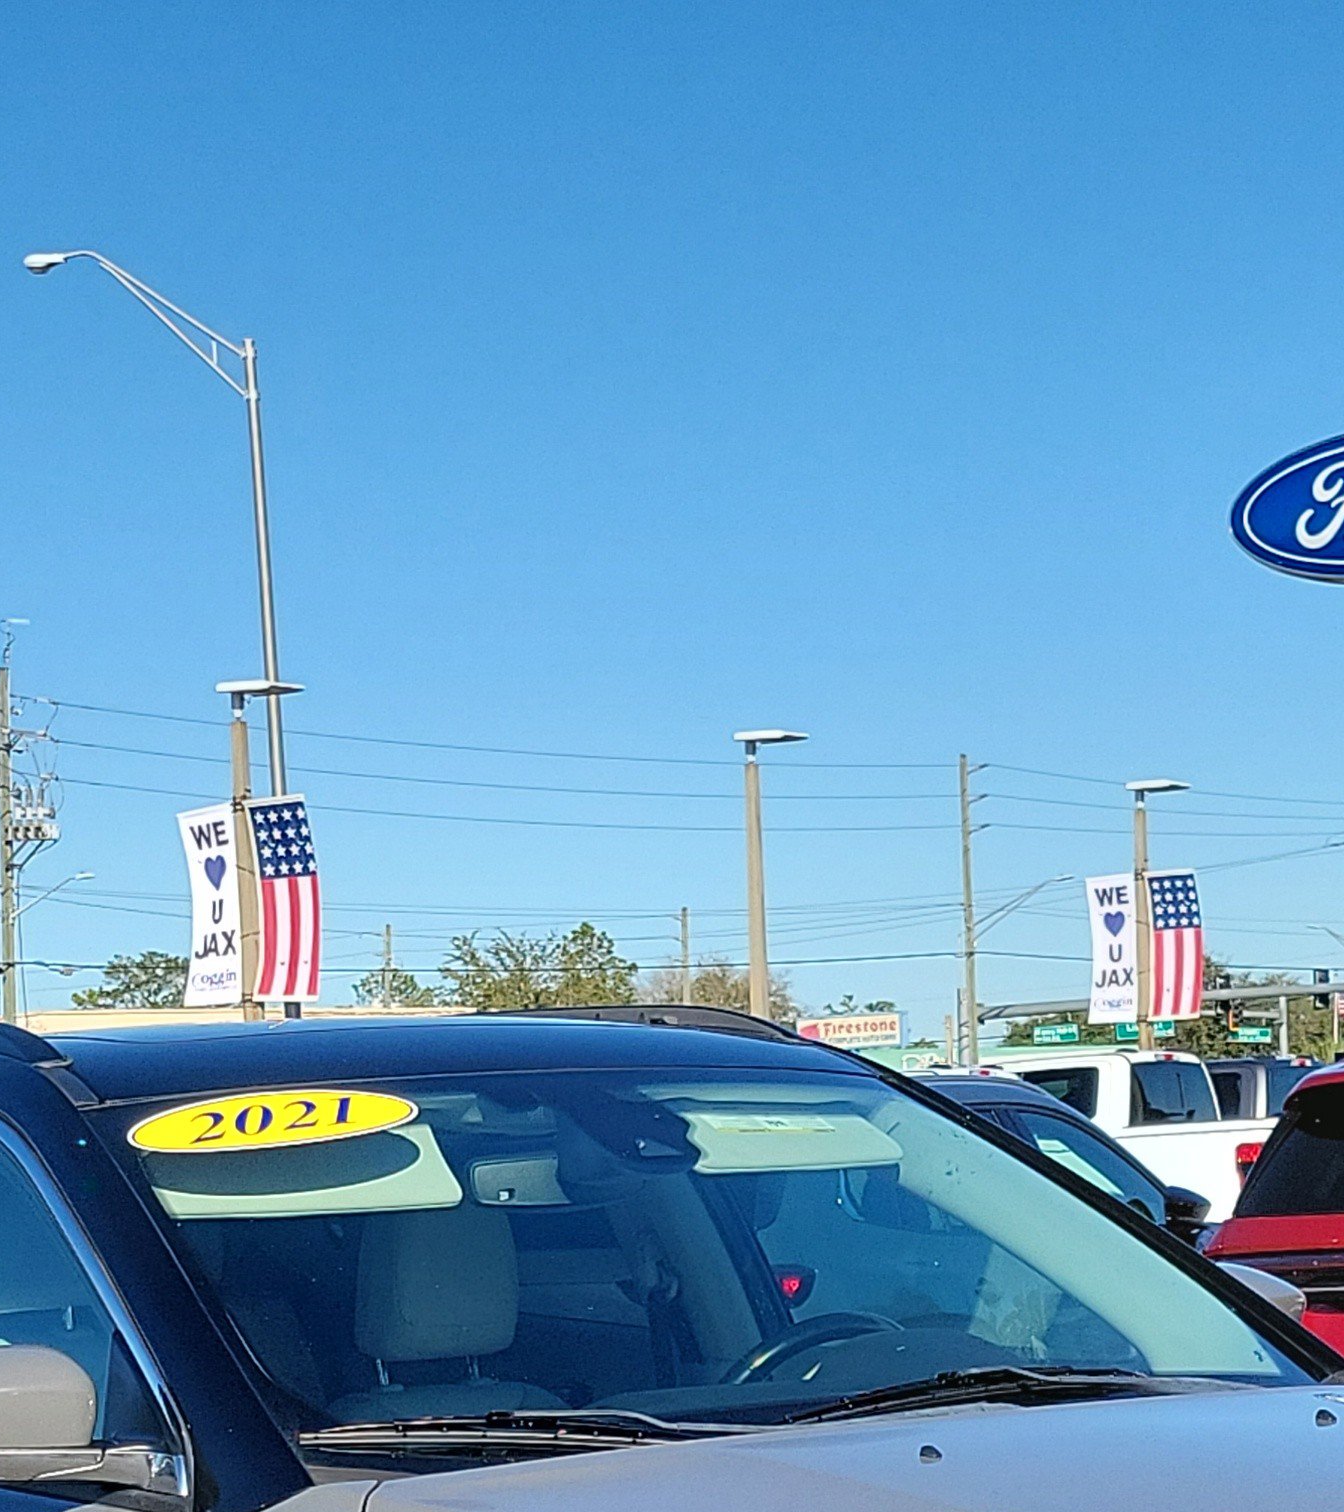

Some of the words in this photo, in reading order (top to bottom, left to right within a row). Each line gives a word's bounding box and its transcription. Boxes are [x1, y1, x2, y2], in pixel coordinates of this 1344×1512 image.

[189, 820, 230, 850] WE
[1094, 885, 1130, 908] WE
[212, 899, 223, 924] U
[194, 929, 237, 960] JAX
[1109, 943, 1122, 963] U
[191, 969, 237, 988] Coggin
[1095, 967, 1134, 988] JAX
[823, 1020, 897, 1038] Firestone
[190, 1096, 358, 1145] 2021
